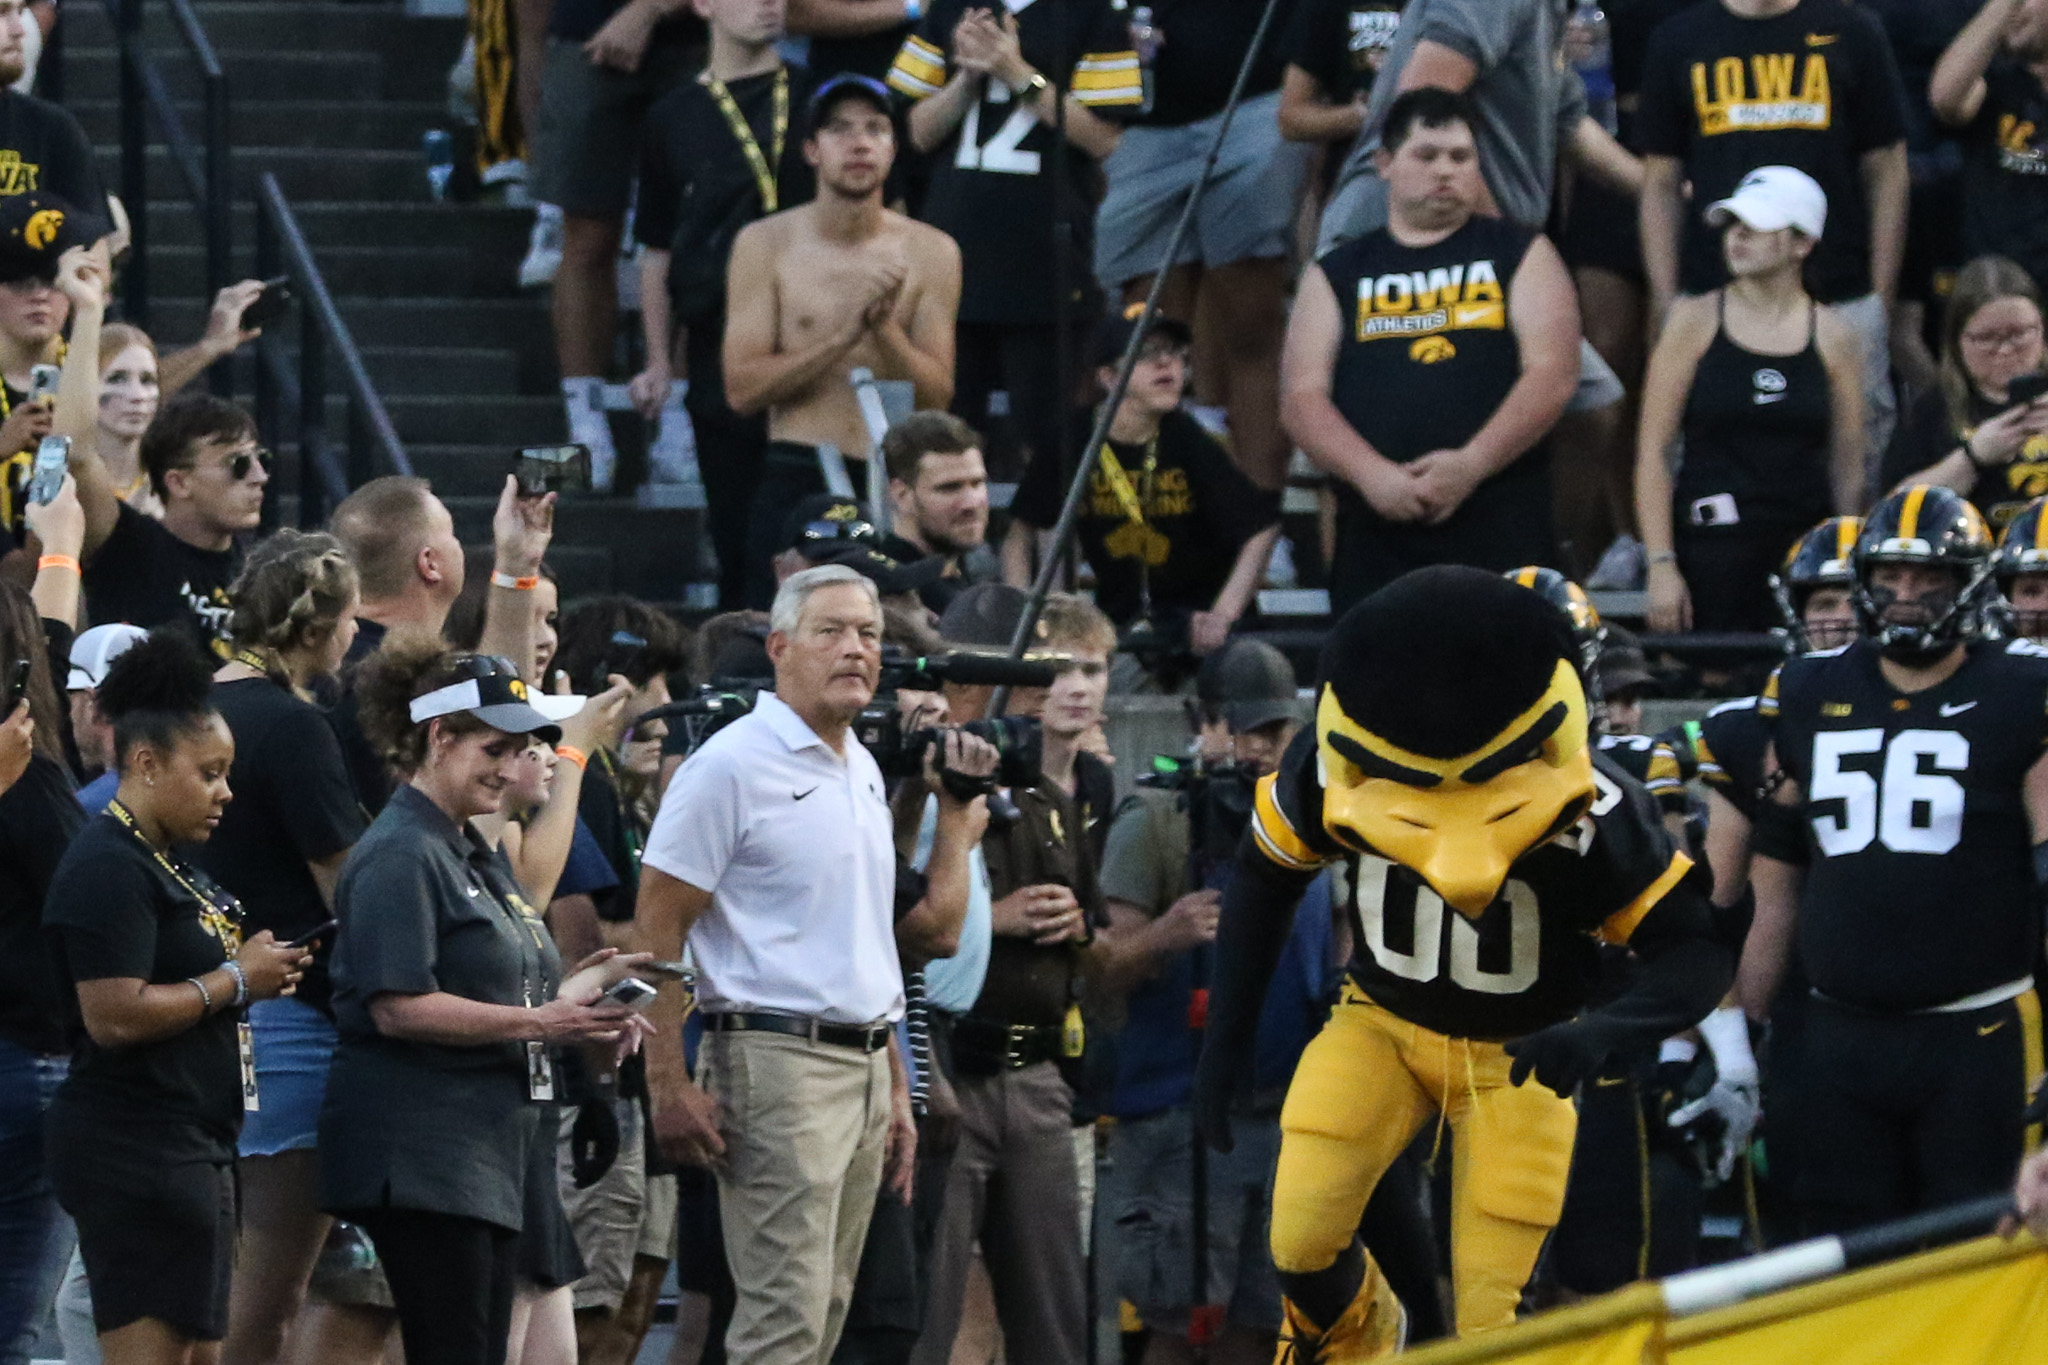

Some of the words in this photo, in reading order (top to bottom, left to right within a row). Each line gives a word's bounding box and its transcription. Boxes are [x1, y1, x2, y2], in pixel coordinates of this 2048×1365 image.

[1691, 53, 1831, 109] IOWA
[1357, 260, 1503, 315] IOWA
[1365, 308, 1448, 335] ATHLETICS
[1810, 728, 1970, 858] 56
